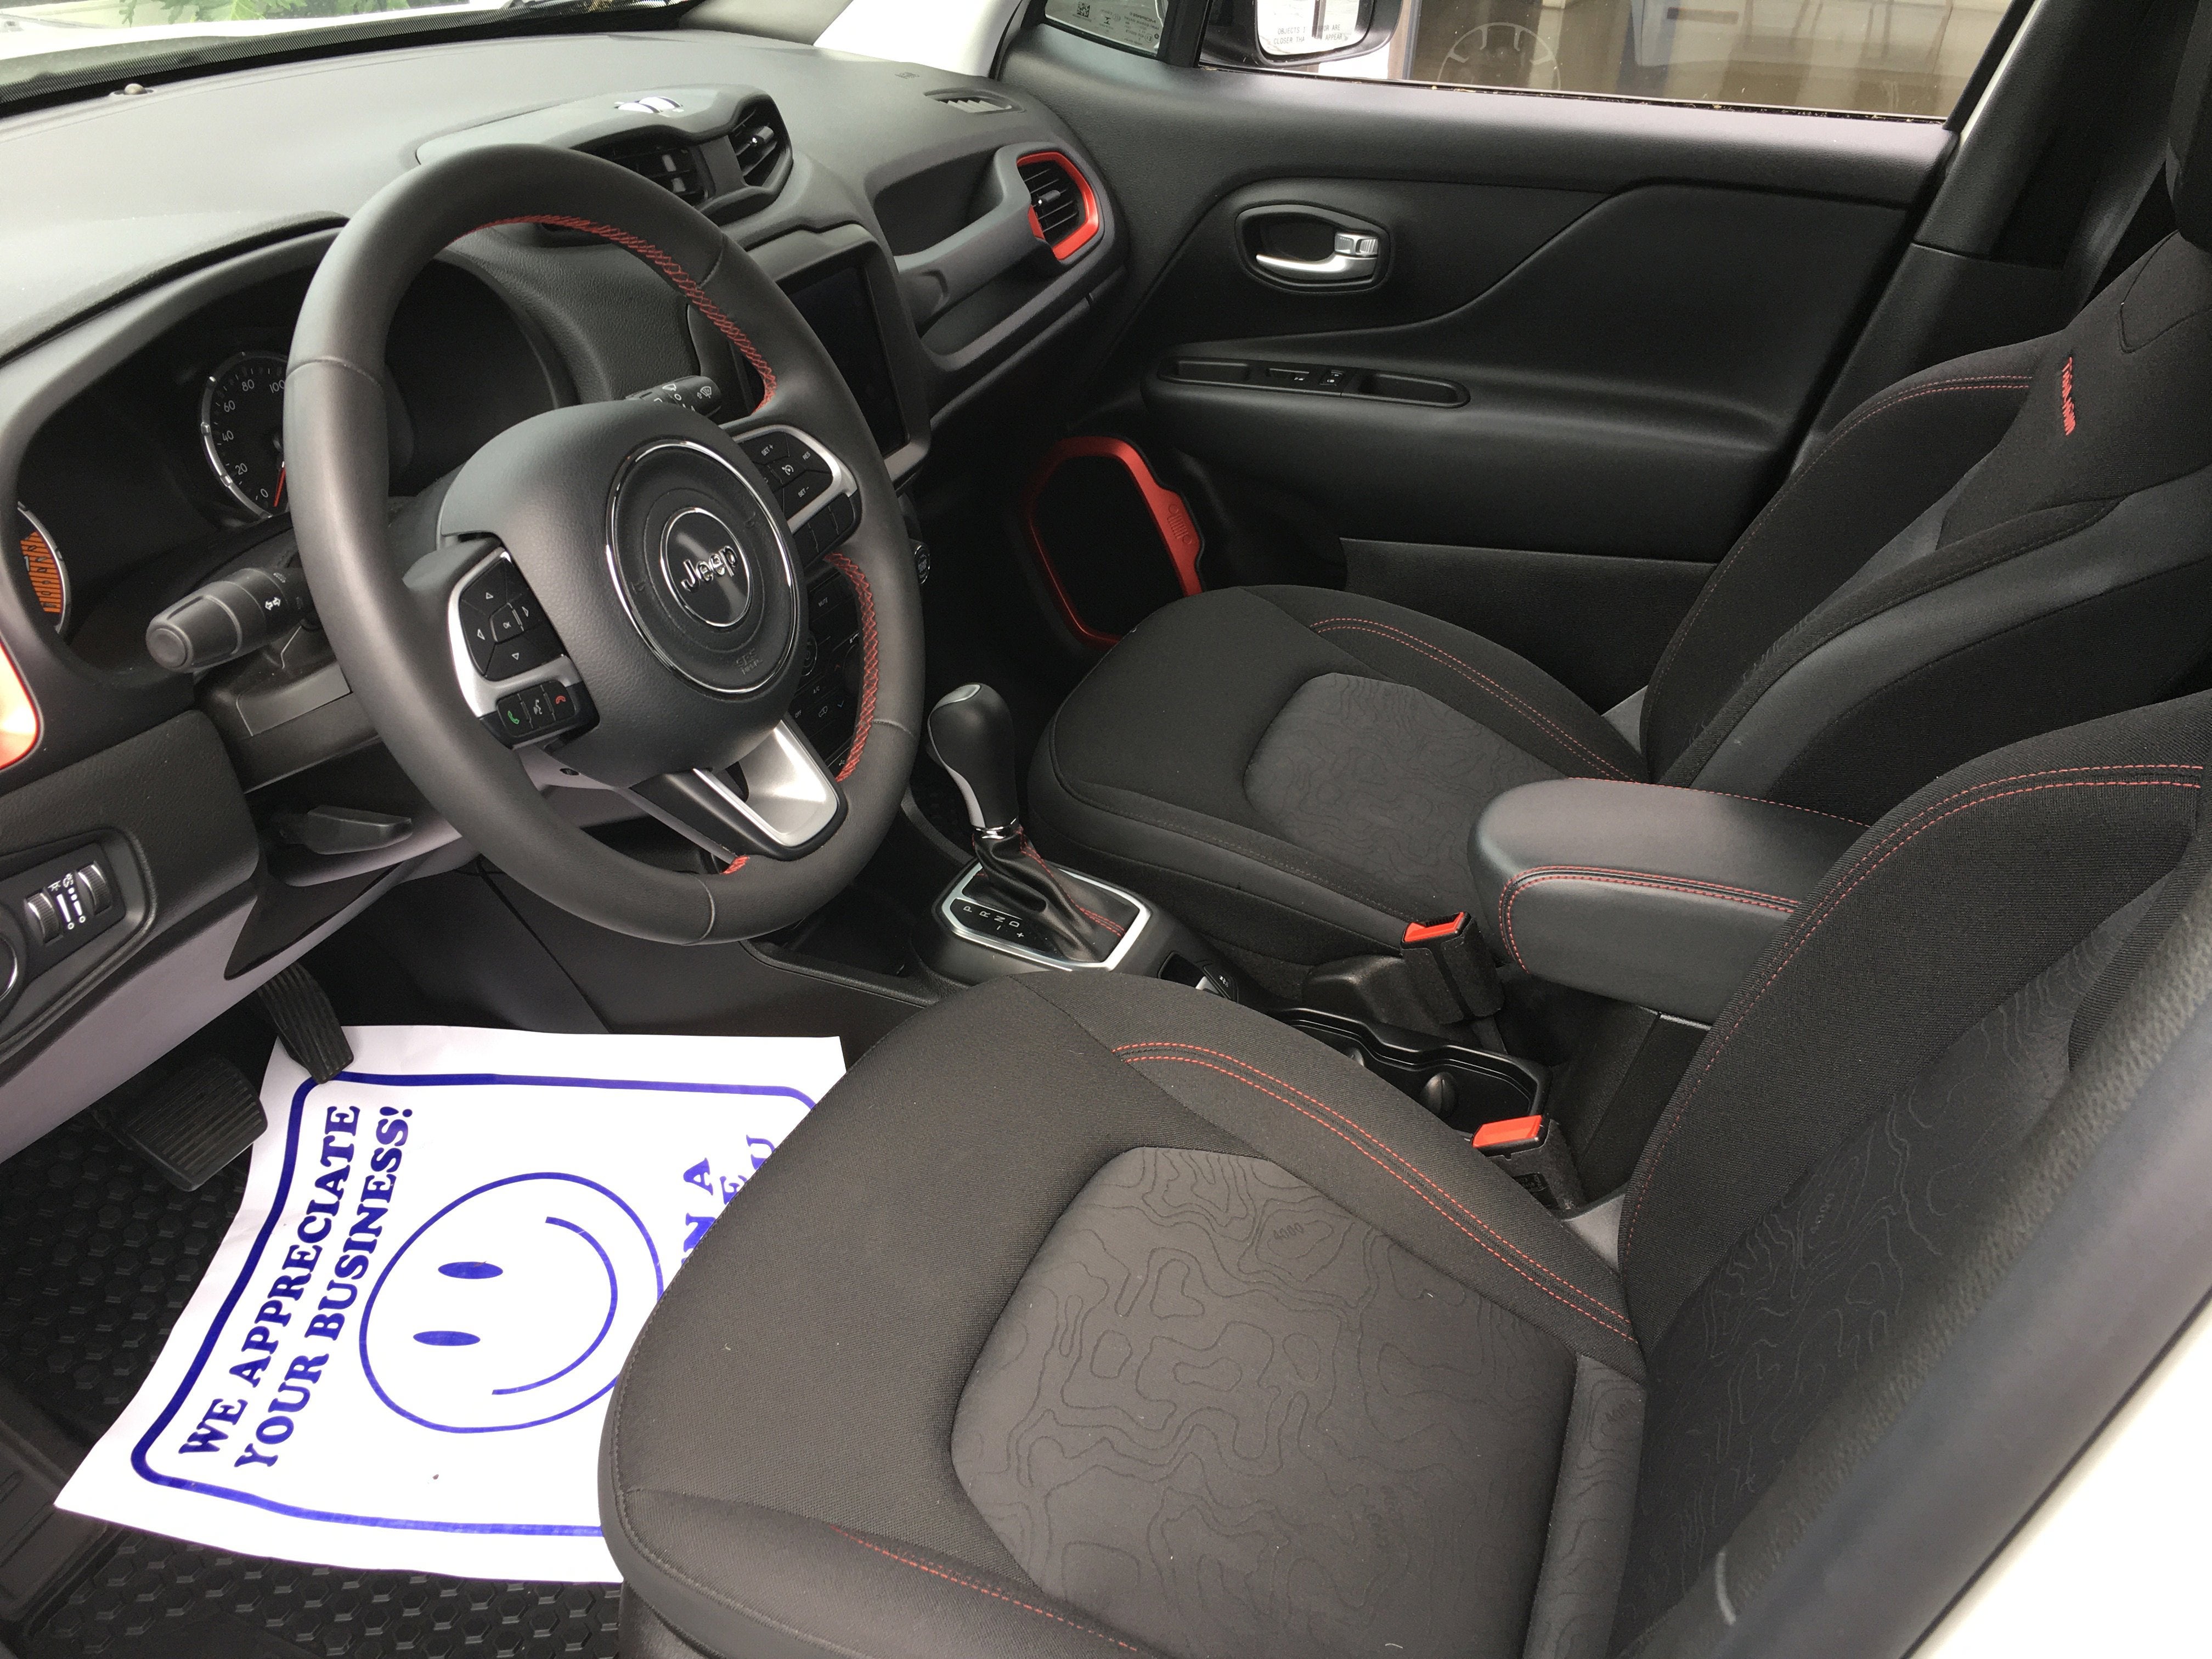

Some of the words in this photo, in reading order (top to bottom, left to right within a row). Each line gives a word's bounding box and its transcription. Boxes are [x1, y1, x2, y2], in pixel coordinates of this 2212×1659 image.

[241, 379, 255, 391] 80
[269, 380, 284, 393] 100
[224, 400, 235, 412] 60
[222, 430, 234, 442] 40
[235, 463, 247, 475] 20
[260, 488, 269, 498] 0
[681, 545, 738, 592] Jeep
[178, 1398, 249, 1454] WE
[229, 1105, 360, 1388] APPRECIATE
[234, 1353, 330, 1468] YOUR
[304, 1106, 413, 1341] BUSINESS!
